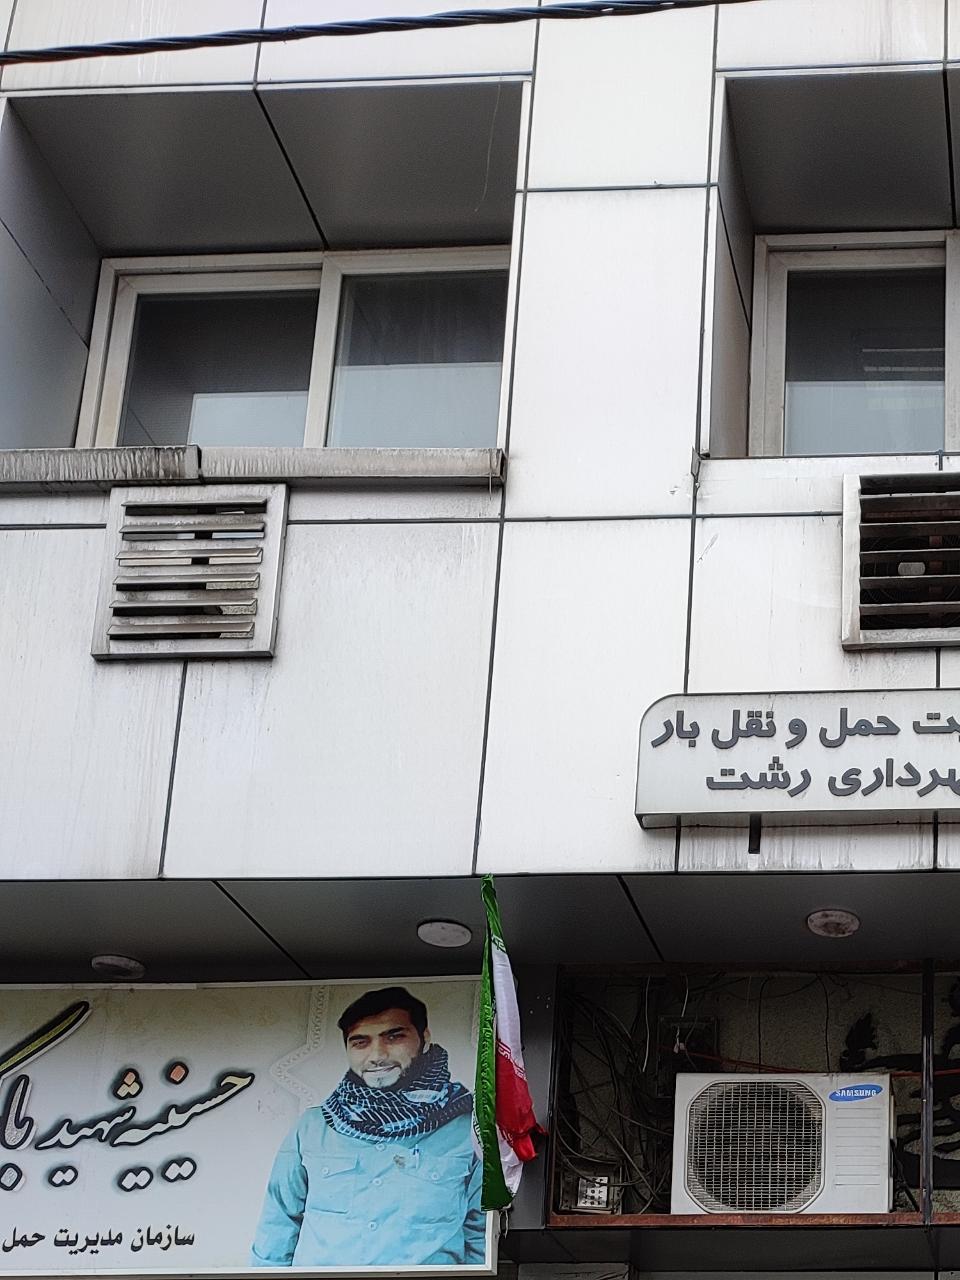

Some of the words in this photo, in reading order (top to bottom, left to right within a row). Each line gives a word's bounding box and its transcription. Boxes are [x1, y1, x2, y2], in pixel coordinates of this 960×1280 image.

[650, 708, 701, 749] بار
[711, 709, 777, 750] نقل
[785, 718, 808, 750] و
[819, 707, 901, 749] حمل
[705, 756, 812, 798] رشت
[835, 1088, 877, 1098] SAMSUNG
[35, 1068, 143, 1188] شهید
[1, 1226, 46, 1252] حمل
[54, 1227, 123, 1255] مدیریت
[131, 1224, 195, 1252] سازمان
